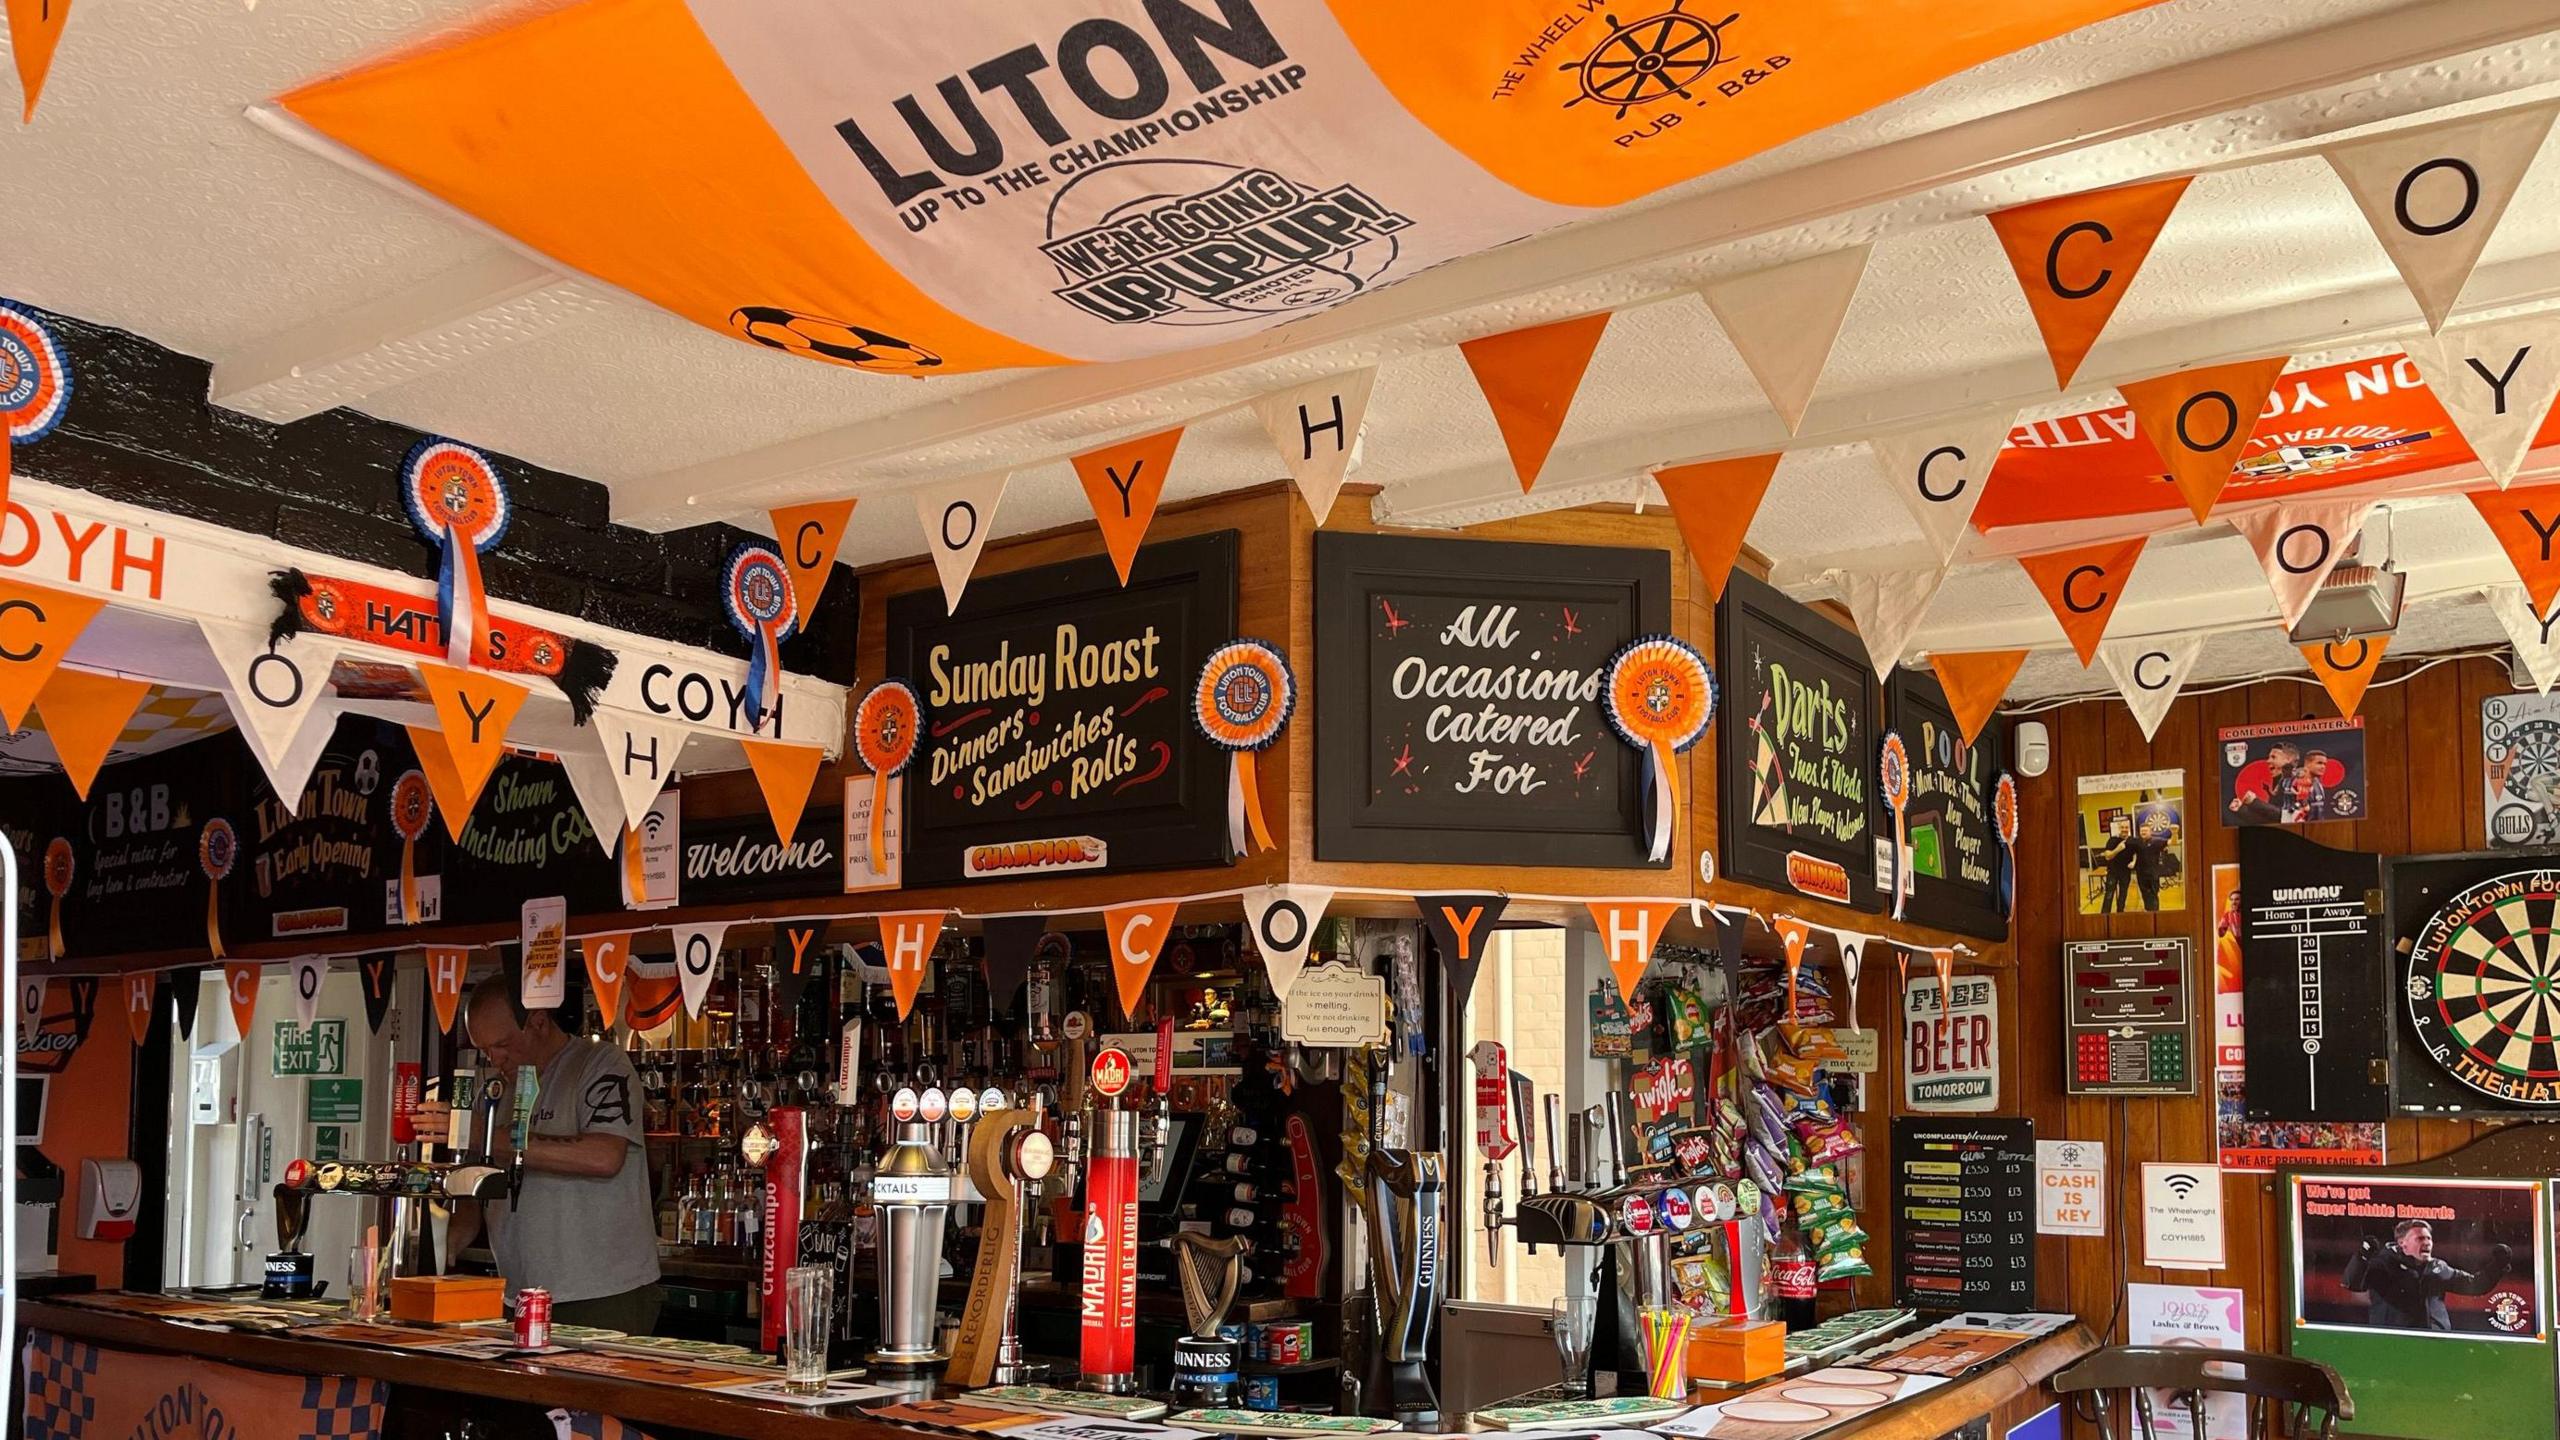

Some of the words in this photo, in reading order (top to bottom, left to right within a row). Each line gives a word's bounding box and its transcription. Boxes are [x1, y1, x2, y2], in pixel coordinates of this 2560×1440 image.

[1493, 70, 1525, 101] THE
[1524, 13, 1581, 71] WHEEL
[835, 0, 1288, 207] LUTON
[1614, 112, 1682, 148] PUB
[1717, 52, 1792, 99] B&B
[898, 201, 943, 233] UP
[951, 183, 986, 212] TO
[991, 162, 1050, 196] THE
[1056, 64, 1307, 174] CHAMPIONSHIP
[1053, 218, 1169, 279] WE'RE
[1158, 173, 1292, 239] GOING
[2046, 221, 2113, 299] C
[2394, 157, 2479, 236] O
[1067, 275, 1177, 320] UP
[1158, 244, 1256, 294] UP
[1242, 189, 1407, 261] UP!
[10, 378, 33, 403] CLUB
[1918, 446, 1967, 501] C
[2176, 391, 2238, 452] O
[2464, 345, 2532, 415] Y
[2063, 565, 2107, 613] C
[2276, 524, 2330, 574] O
[1440, 605, 1521, 649] All
[929, 639, 1046, 708] Sunday
[1054, 623, 1161, 692] Roast
[1218, 667, 1243, 691] LUTON
[1243, 666, 1267, 688] TOWN
[1391, 649, 1604, 701] Occasions
[2133, 651, 2172, 690] C
[640, 663, 783, 739] COYH
[1217, 696, 1256, 722] FOOTBALL
[1254, 692, 1269, 715] CLUB
[1769, 663, 1849, 755] Darts
[1425, 702, 1582, 746] Catered
[2225, 725, 2257, 739] COME
[2258, 725, 2275, 735] ON
[2277, 722, 2300, 734] YOU
[930, 708, 1024, 786] Dinners
[971, 705, 1115, 806] Sandwiches
[1070, 734, 1138, 800] Rolls
[1454, 749, 1547, 795] For
[1788, 741, 1819, 788] Tues.
[317, 769, 369, 825] Town
[493, 770, 559, 815] Shown
[105, 783, 170, 838] B&B
[1791, 795, 1809, 827] New
[1809, 796, 1835, 836] Players
[1836, 808, 1866, 842] Welcome
[1945, 798, 1963, 827] New
[2498, 814, 2530, 835] BULLS
[274, 836, 311, 881] Early
[312, 832, 372, 879] Opening
[459, 814, 548, 869] Including
[686, 835, 833, 880] Welcome
[1790, 858, 1849, 897] CHAMPIONS
[1960, 855, 1990, 885] Welcome
[2265, 910, 2295, 921] Home
[2323, 907, 2351, 918] Away
[2291, 923, 2302, 933] 01
[2349, 921, 2360, 930] 01
[2427, 905, 2472, 954] LUTON
[2472, 880, 2525, 910] TOWN
[2303, 938, 2316, 948] 20
[2303, 955, 2315, 965] 19
[1296, 988, 1307, 998] the
[1309, 989, 1321, 998] ice
[1334, 990, 1352, 999] your
[1353, 989, 1379, 998] drinks
[2304, 972, 2316, 982] 18
[2304, 989, 2316, 999] 17
[1296, 1013, 1321, 1022] you're
[1322, 1013, 1335, 1021] not
[1336, 1013, 1370, 1023] drinking
[2305, 1006, 2317, 1016] 16
[1306, 1025, 1320, 1033] fast
[1321, 1025, 1356, 1035] enough
[1911, 1013, 1991, 1076] BEER
[2305, 1023, 2317, 1034] 15
[280, 1050, 313, 1070] EXIT
[2455, 1052, 2506, 1095] THE
[1918, 1081, 1985, 1099] TOMORROW
[1373, 1104, 1384, 1143] GUINNESS
[1913, 1132, 1967, 1141] UNCOMPLICATED
[1963, 1130, 2009, 1144] pleasure
[2006, 1164, 2021, 1174] £13
[2237, 1155, 2251, 1167] WE
[2254, 1155, 2273, 1167] ARE
[2008, 1186, 2023, 1197] £13
[2045, 1174, 2096, 1189] CASH
[2305, 1184, 2346, 1200] We've
[2347, 1186, 2371, 1201] got
[2056, 1208, 2091, 1222] KEY
[2063, 1192, 2083, 1205] IS
[2150, 1206, 2165, 1214] The
[2168, 1206, 2216, 1216] Wheelwright
[2306, 1201, 2346, 1217] Super
[2348, 1203, 2395, 1218] Robbie
[2397, 1204, 2455, 1221] Edwards
[1123, 1202, 1137, 1251] MADRID
[2008, 1210, 2023, 1222] £13
[2172, 1216, 2195, 1225] Arms
[762, 1182, 780, 1297] cruzcampo
[1418, 1215, 1436, 1289] GUINNESS
[2009, 1233, 2024, 1245] £13
[1122, 1254, 1136, 1271] DE
[2010, 1256, 2026, 1269] £13
[963, 1225, 1001, 1346] REKORDERLIG
[1121, 1273, 1135, 1309] ALMA
[2010, 1280, 2026, 1292] £13
[1120, 1314, 1133, 1328] EL
[2152, 1319, 2180, 1330] Lashes
[2193, 1322, 2221, 1332] Brows
